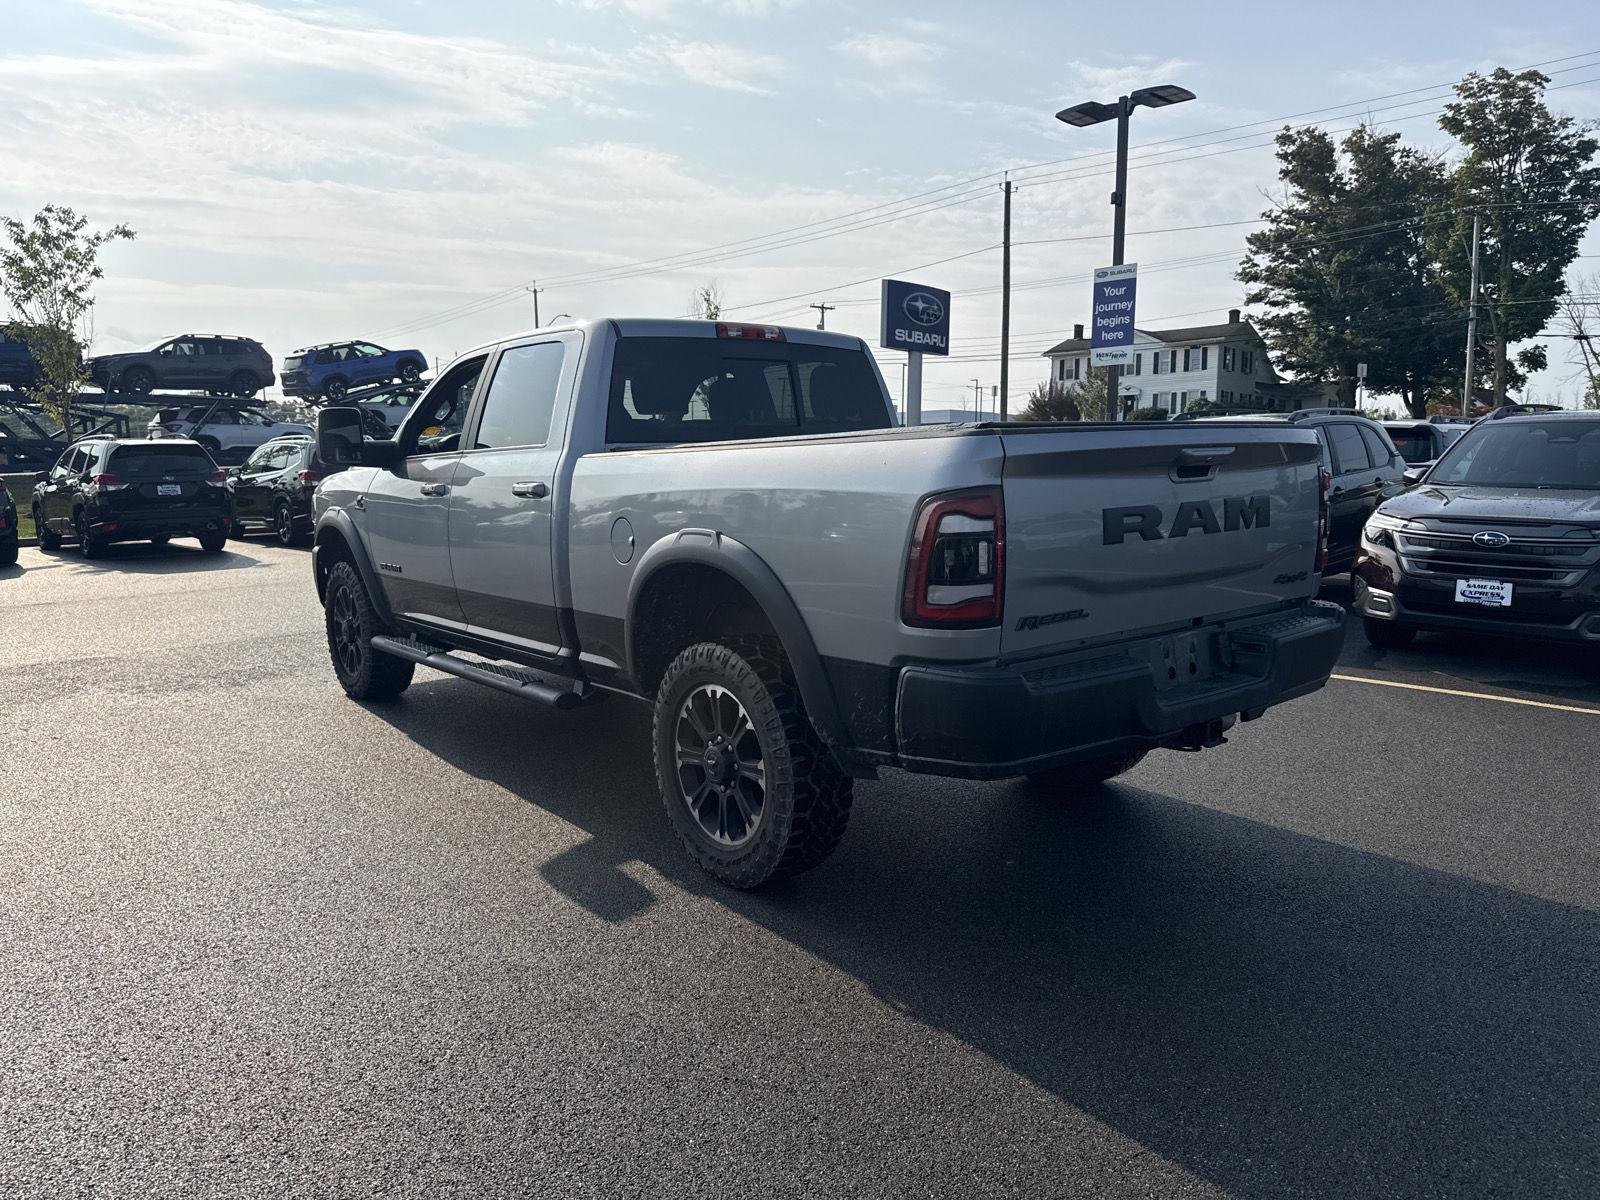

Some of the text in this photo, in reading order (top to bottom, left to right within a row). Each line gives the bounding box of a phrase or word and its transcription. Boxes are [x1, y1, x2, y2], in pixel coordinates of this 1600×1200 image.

[1109, 268, 1136, 276] SUBARU
[1104, 286, 1127, 296] Your
[1095, 300, 1133, 314] journey
[1097, 315, 1130, 327] begins
[894, 328, 946, 347] SUBARU
[1101, 331, 1124, 340] here
[1102, 496, 1271, 545] RAM
[1462, 589, 1501, 597] EXPRESS
[1014, 608, 1090, 631] REBEL
